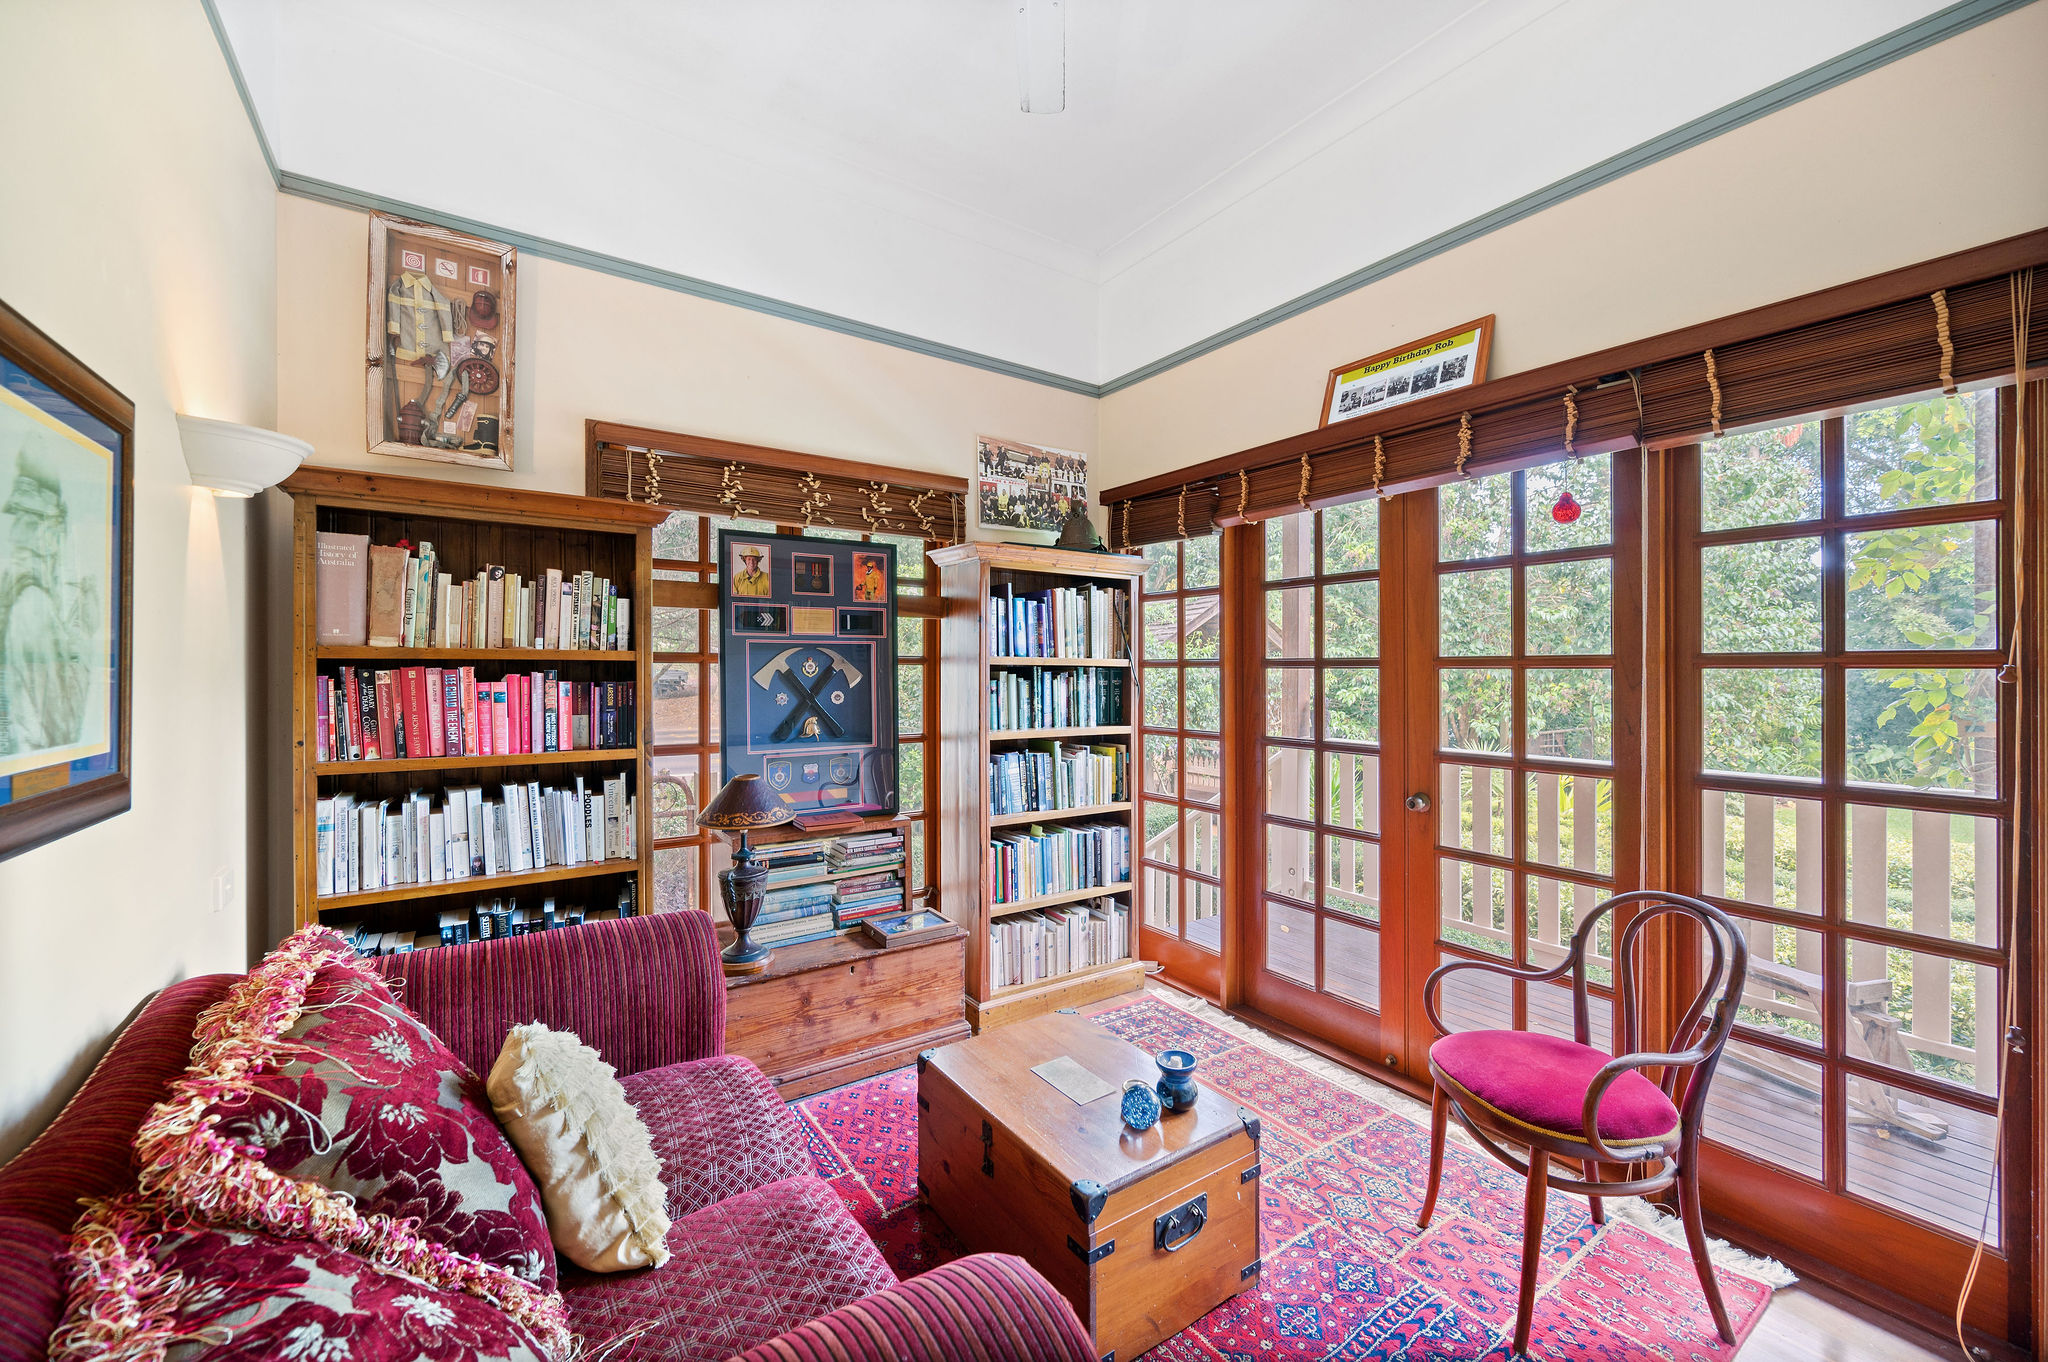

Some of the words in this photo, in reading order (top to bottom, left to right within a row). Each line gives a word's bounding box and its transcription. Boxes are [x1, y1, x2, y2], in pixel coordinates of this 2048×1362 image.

[1363, 360, 1391, 375] Happy
[1392, 347, 1432, 365] Birthday
[1434, 339, 1454, 351] Rob
[317, 542, 355, 551] Illustrated
[348, 551, 358, 560] of
[317, 557, 356, 567] Australia
[405, 613, 414, 625] Day
[445, 674, 457, 685] LEE
[446, 686, 457, 707] CHILD
[545, 680, 556, 709] JESTER
[431, 704, 441, 739] ENGLAND
[447, 710, 457, 722] THE
[363, 716, 371, 743] COOPER
[448, 723, 458, 743] ENEMY
[608, 782, 616, 816] Vincenzi
[584, 794, 592, 829] POODLES
[482, 916, 490, 938] SLEUTH
[497, 914, 509, 932] Lynda
